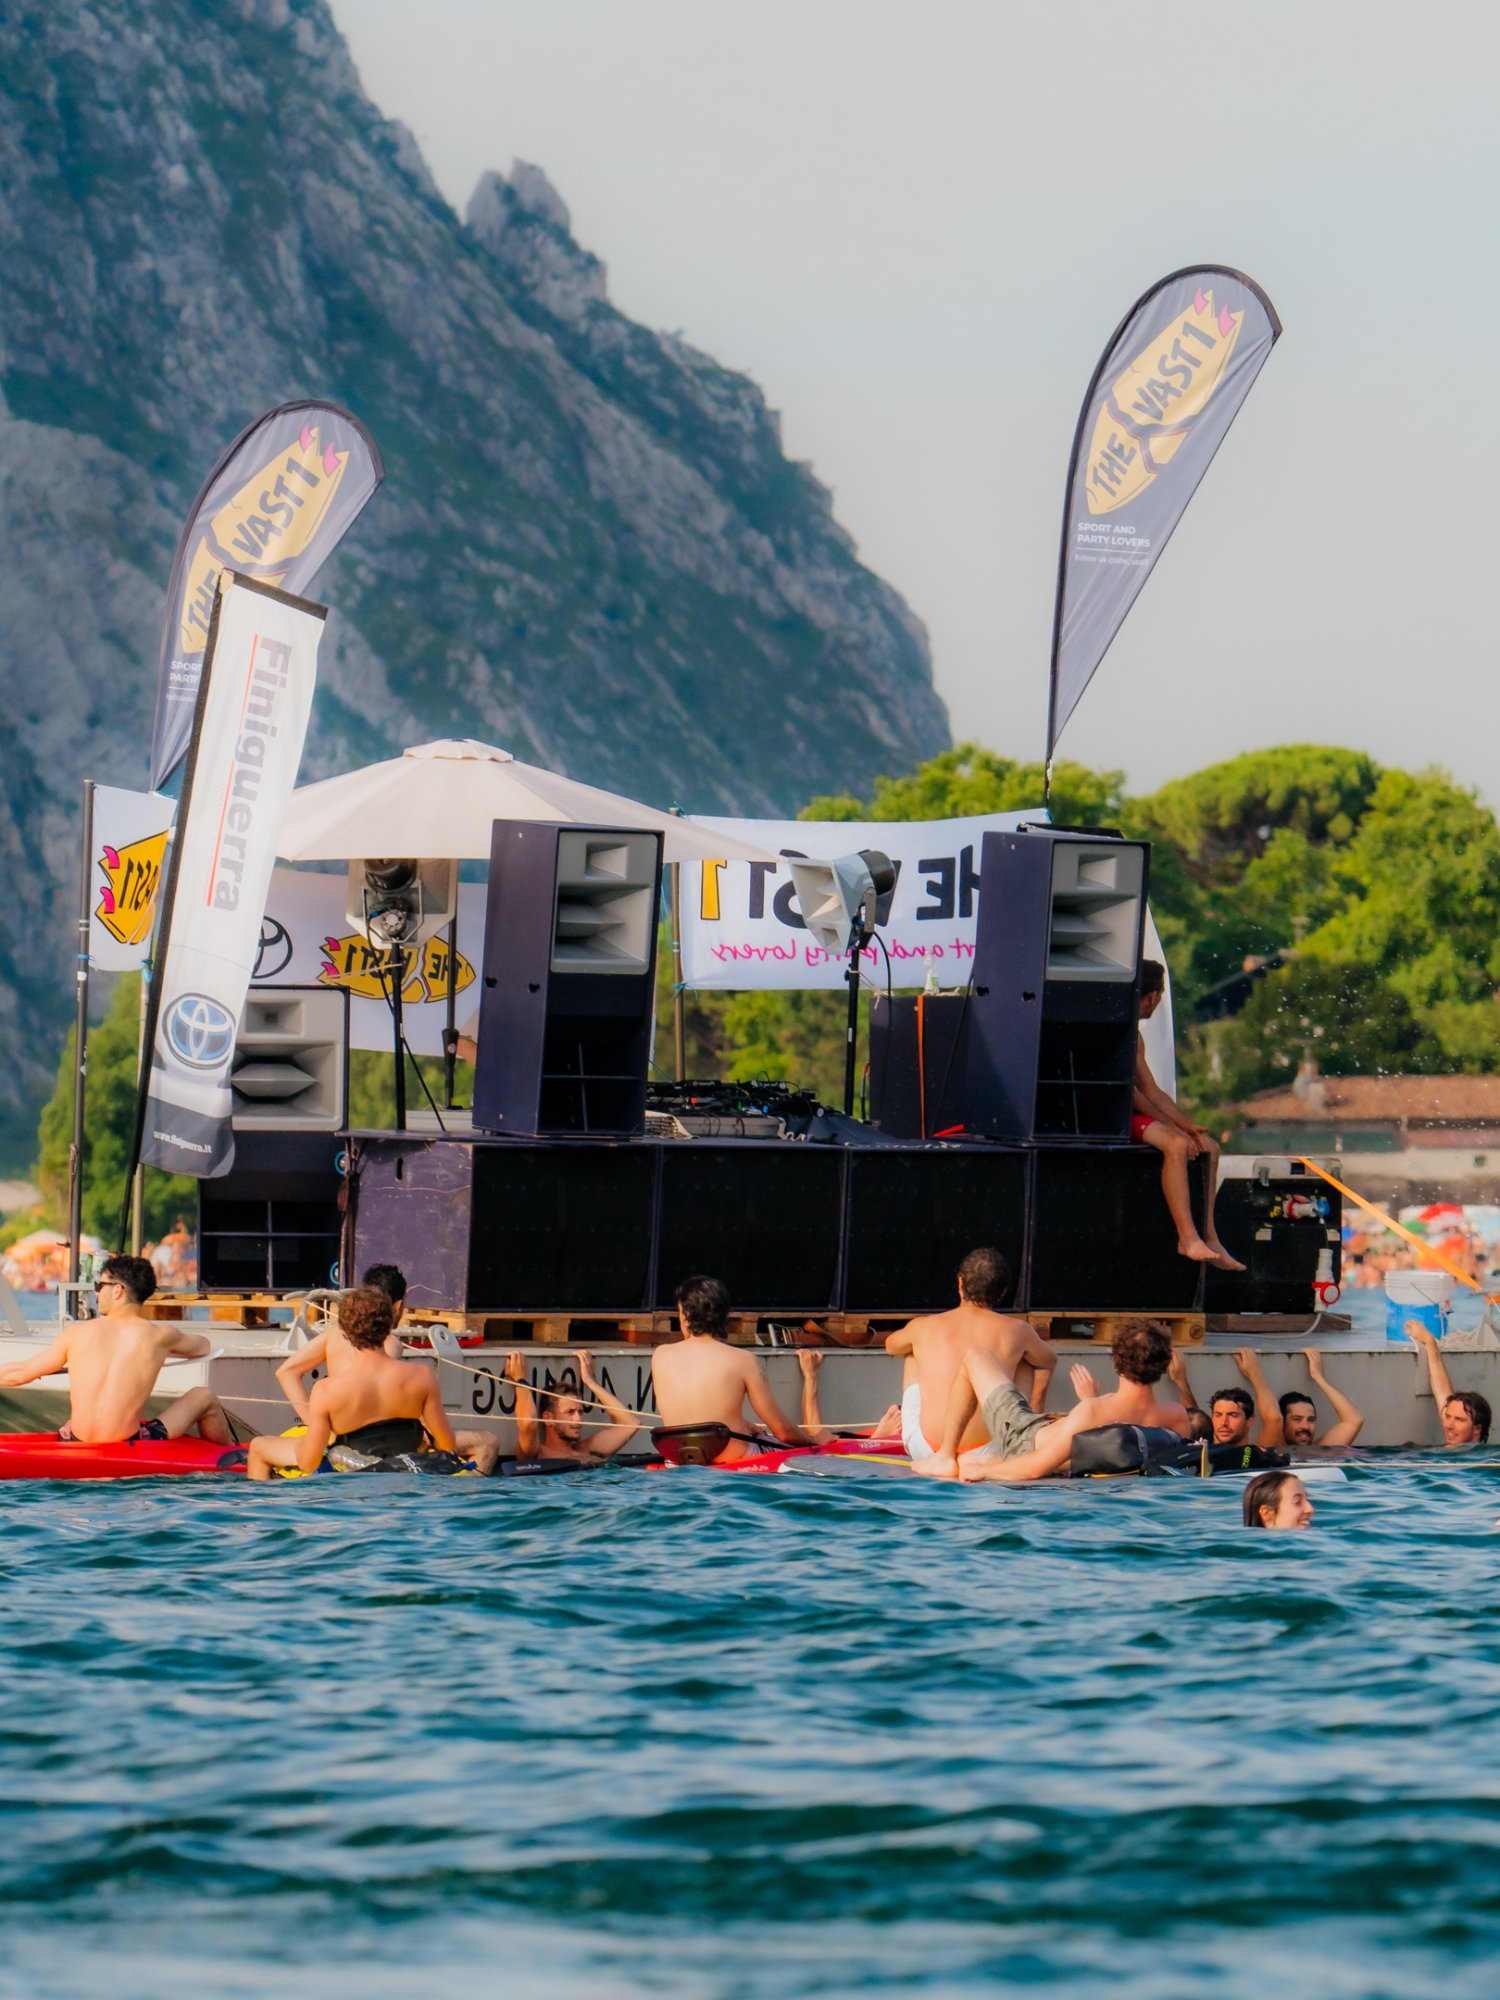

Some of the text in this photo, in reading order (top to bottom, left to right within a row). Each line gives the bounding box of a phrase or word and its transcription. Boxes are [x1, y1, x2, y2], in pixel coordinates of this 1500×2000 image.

[1092, 432, 1137, 497] THE
[1077, 522, 1136, 535] SPORT AND
[1077, 534, 1151, 548] PARTY LOVERS
[170, 660, 203, 672] SPORT
[214, 636, 293, 912] Finiguerra
